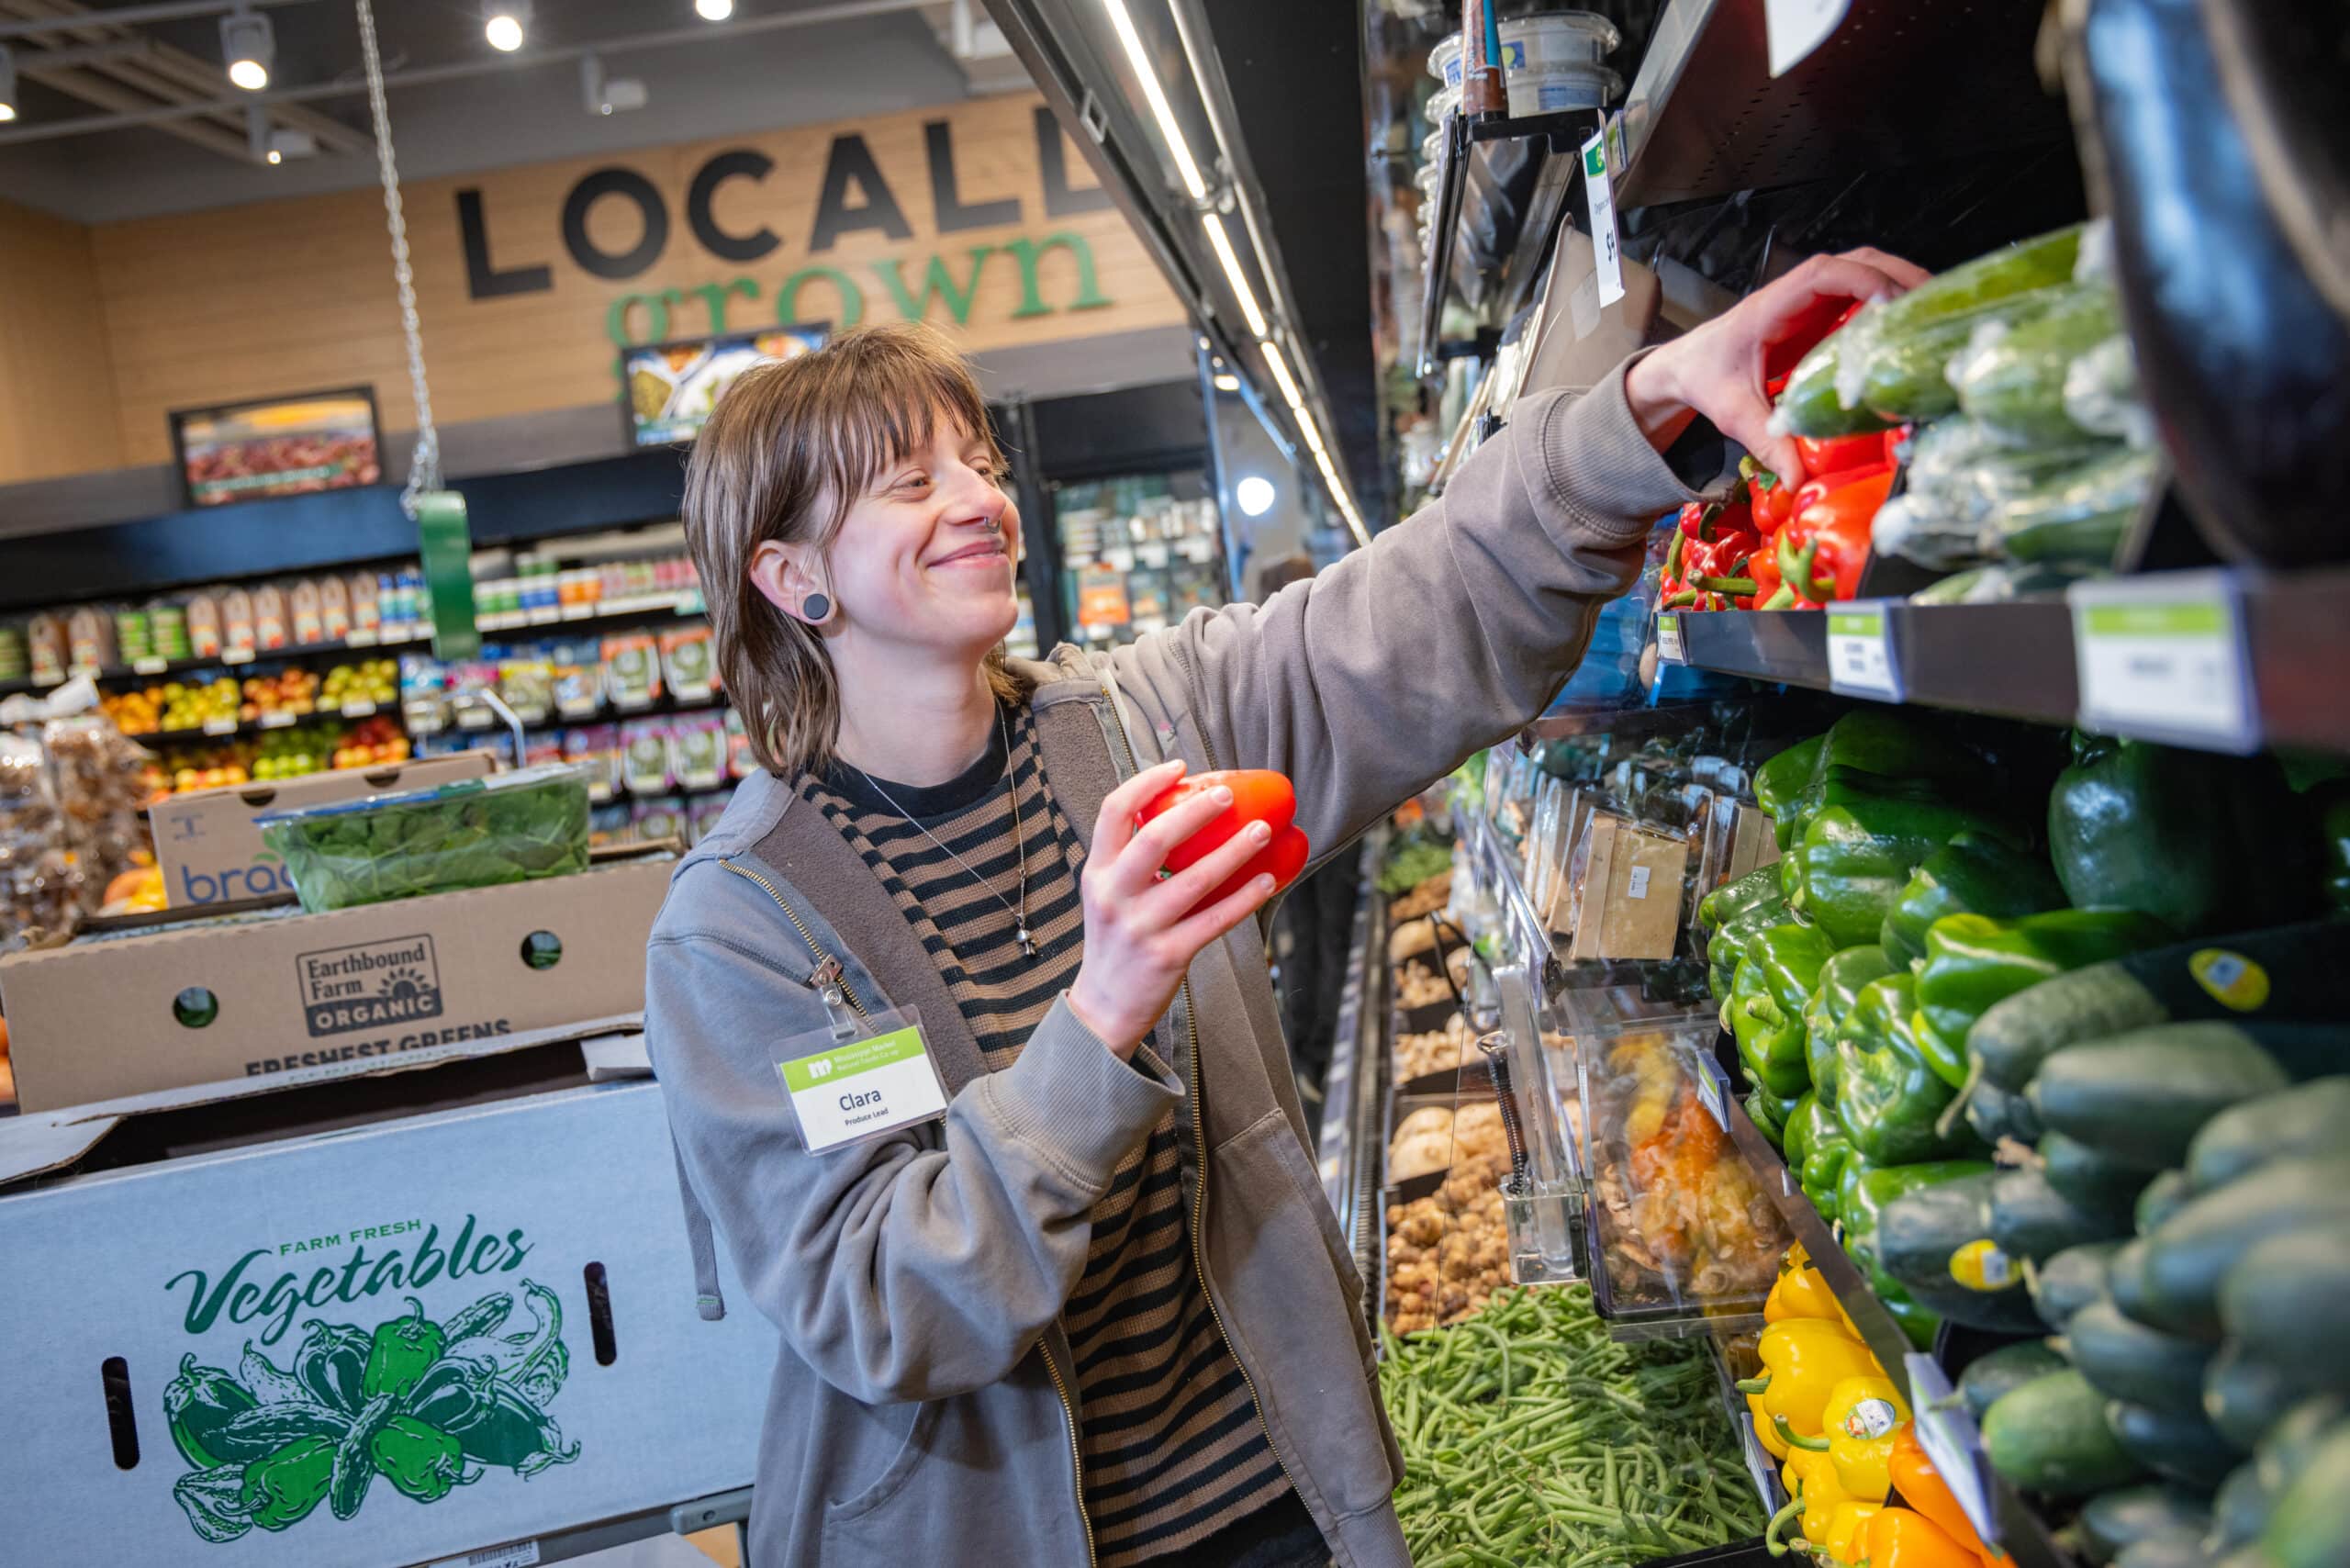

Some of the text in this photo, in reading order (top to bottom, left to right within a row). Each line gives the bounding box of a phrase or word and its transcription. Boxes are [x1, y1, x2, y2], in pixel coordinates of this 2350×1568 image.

[605, 231, 1114, 401] grown
[307, 943, 425, 979] Earthbound
[310, 980, 363, 1000] Farm
[315, 995, 434, 1028] ORGANIC
[245, 1019, 511, 1076] FRESHEST GREENS
[839, 1090, 881, 1111] Clara
[845, 1107, 889, 1126] Produce Lead
[279, 1218, 422, 1256] FARM FRESH
[164, 1214, 535, 1346] Vegetables
